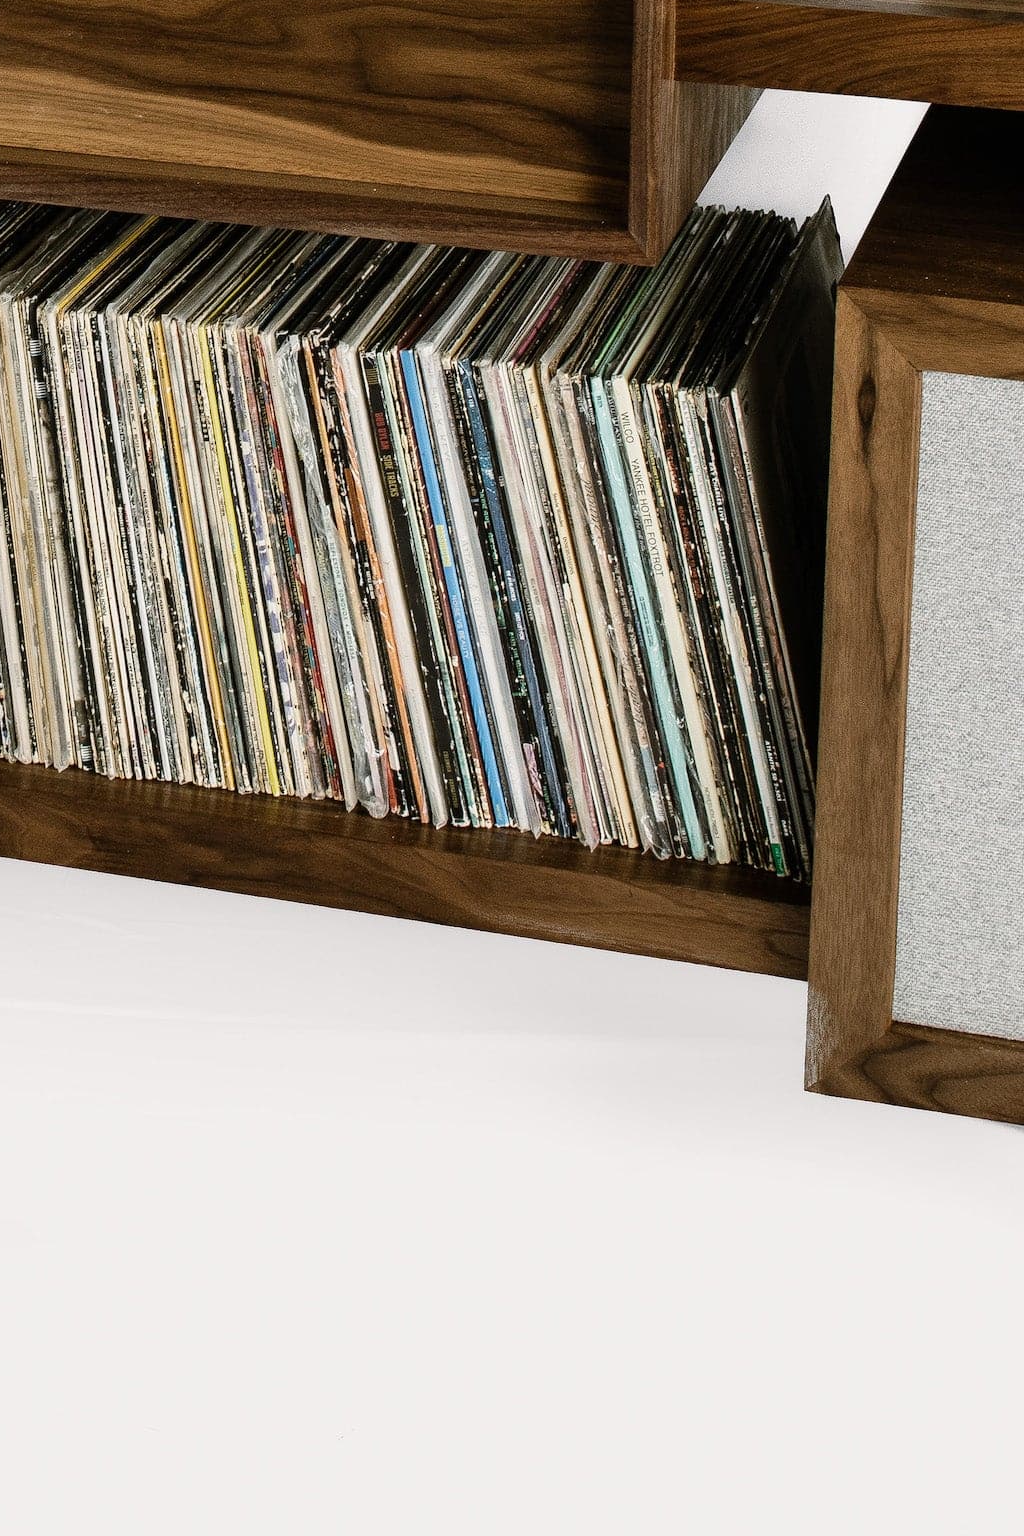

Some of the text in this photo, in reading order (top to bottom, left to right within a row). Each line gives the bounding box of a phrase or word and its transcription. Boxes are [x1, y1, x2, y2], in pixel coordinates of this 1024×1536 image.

[619, 410, 635, 444] WILCO
[373, 410, 400, 499] BOB DYLAN SIDE TRACKS
[630, 457, 646, 497] YANKEE
[638, 497, 654, 531] HOTEL
[646, 530, 664, 579] FOXTROT
[710, 475, 721, 505] CHARLES
[716, 504, 725, 522] LIVE
[749, 594, 766, 649] The White Stripes
[764, 738, 776, 771] ATLANTIC
